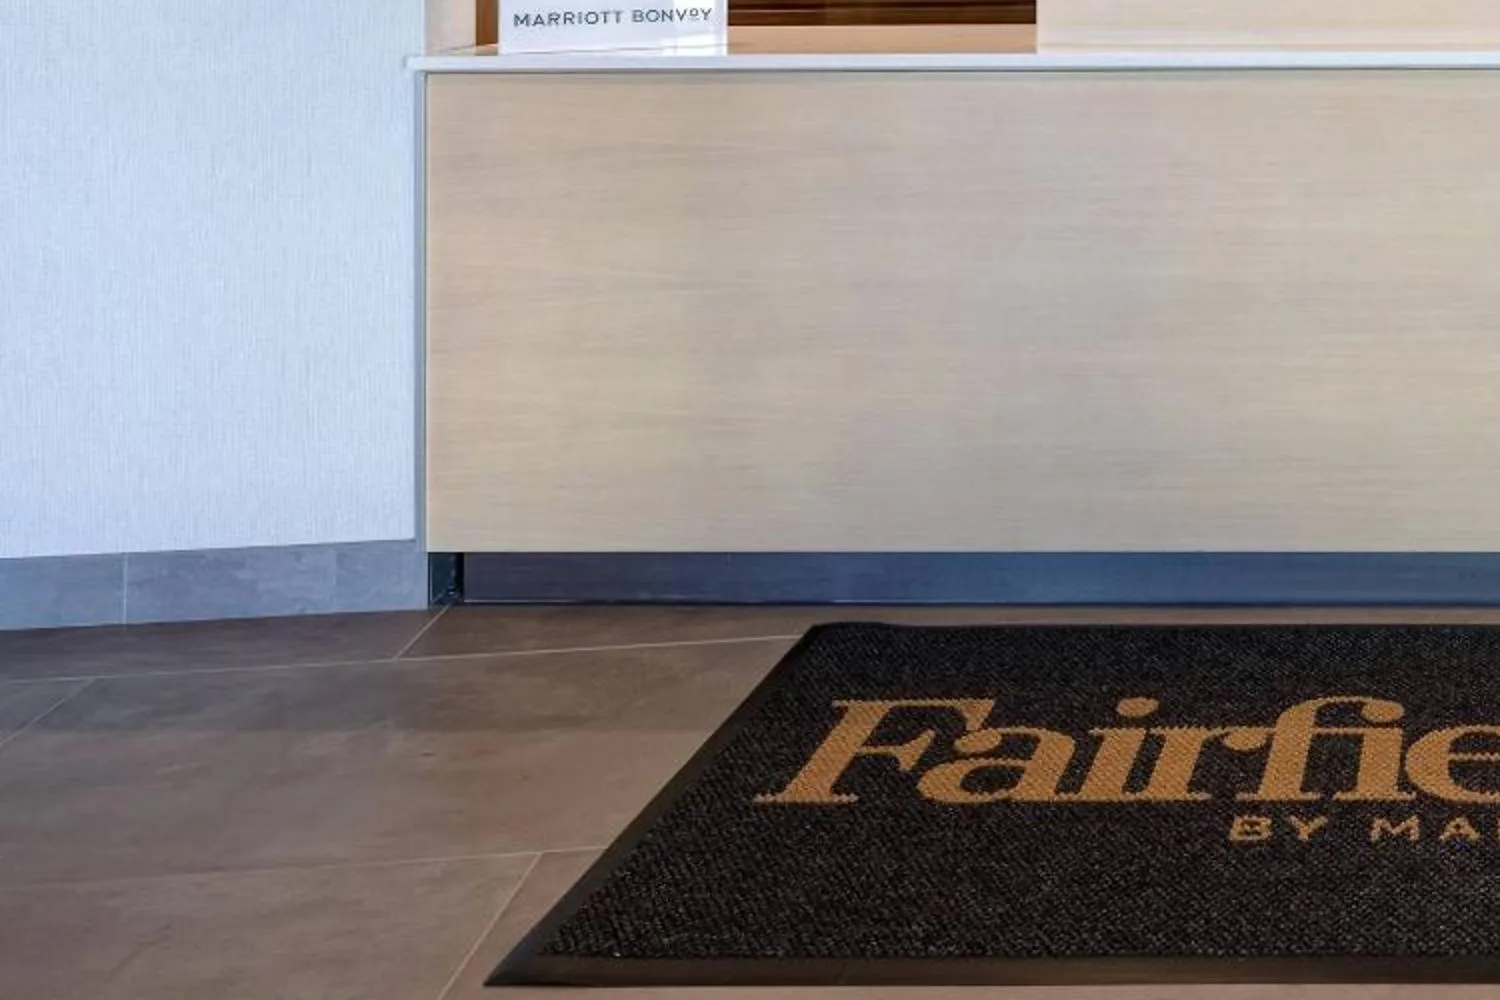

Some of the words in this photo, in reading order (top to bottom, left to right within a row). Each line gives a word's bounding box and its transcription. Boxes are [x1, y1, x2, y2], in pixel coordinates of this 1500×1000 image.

[513, 10, 623, 27] MARRIOTT
[631, 7, 712, 24] BONVOY
[1228, 815, 1328, 842] BY
